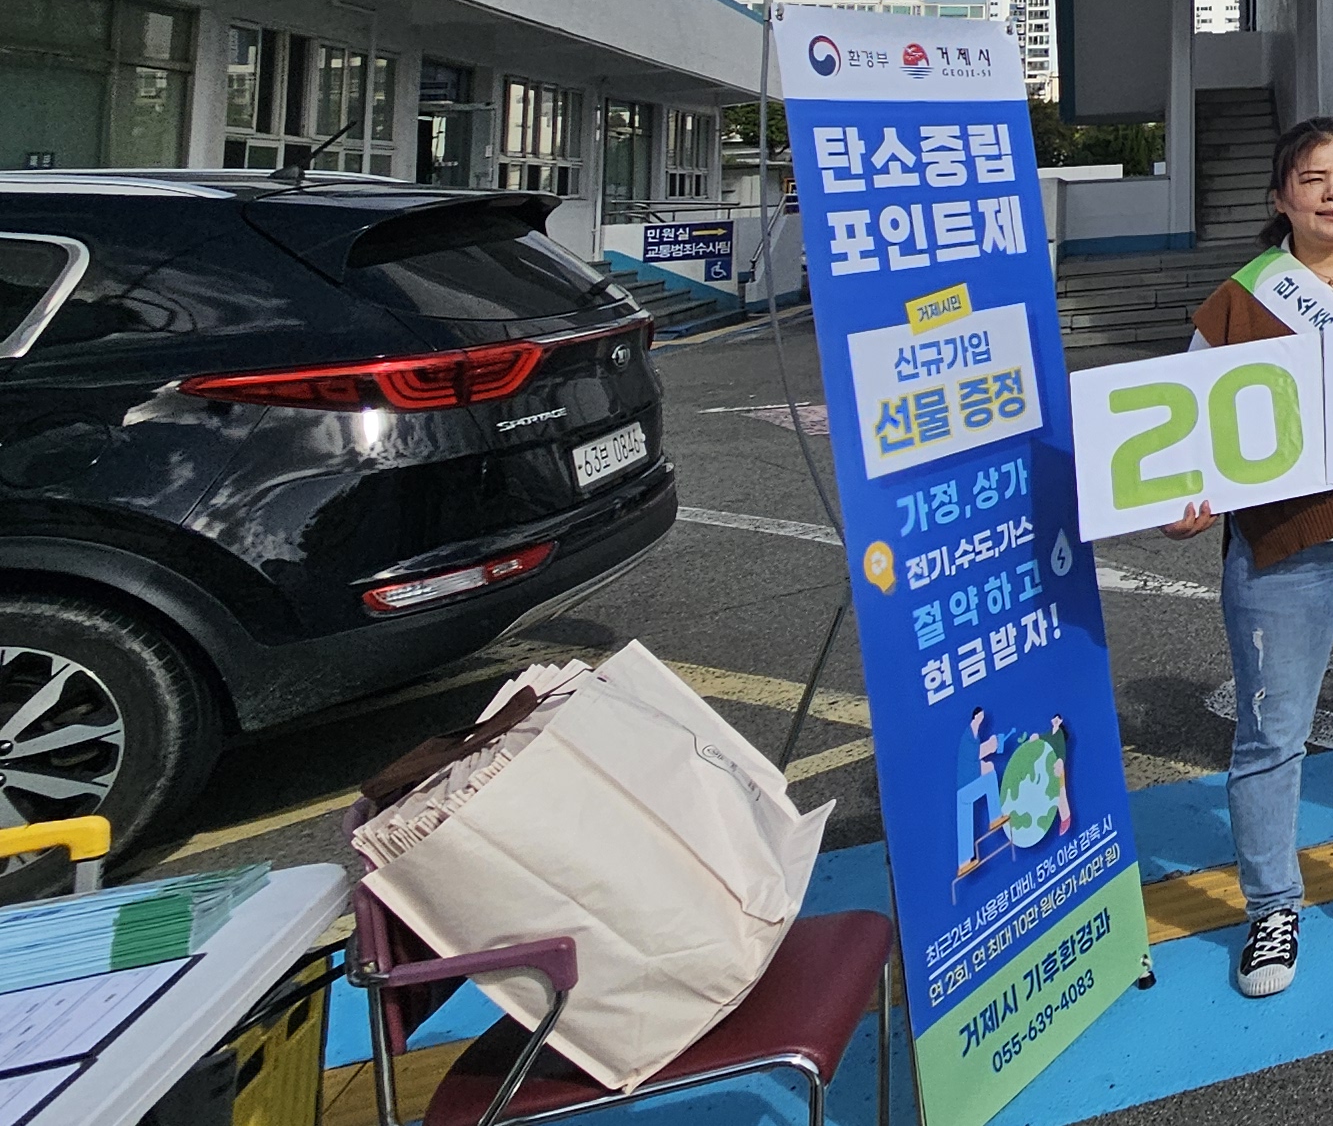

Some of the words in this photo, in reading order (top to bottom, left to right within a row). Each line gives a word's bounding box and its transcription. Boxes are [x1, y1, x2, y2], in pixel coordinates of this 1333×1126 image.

[848, 49, 889, 68] 환경부
[936, 46, 992, 67] 거제시
[942, 69, 992, 77] GEOJE-SI
[813, 124, 1016, 194] 탄소중립
[645, 240, 731, 259] 교통범죄수사팀
[646, 226, 690, 242] 민원실
[826, 195, 1028, 277] 포인트제
[917, 293, 962, 322] 거제시민
[894, 330, 992, 383] 신규가입
[496, 407, 568, 432] SPORTAGE
[876, 386, 951, 457] 선물
[958, 367, 1026, 431] 증정
[905, 516, 1035, 590] 전기,수도,가스
[912, 559, 1043, 651] 절약하고
[921, 602, 1061, 706] 현금받자!
[975, 889, 1010, 931] 사용량
[1009, 875, 1036, 903] 대비,
[1036, 856, 1056, 882] 5%
[1057, 840, 1079, 867] 이상
[1079, 822, 1101, 851] 감축
[1102, 813, 1113, 835] 시
[929, 980, 945, 1008] 연
[945, 961, 972, 994] 2회,
[972, 946, 987, 972] 연
[988, 926, 1013, 960] 최대
[1014, 904, 1040, 935] 10만
[1078, 856, 1105, 886] 40만
[959, 983, 1019, 1058] 거제시
[1023, 906, 1111, 1002] 기후환경과
[992, 968, 1095, 1073] 055-639-4083
